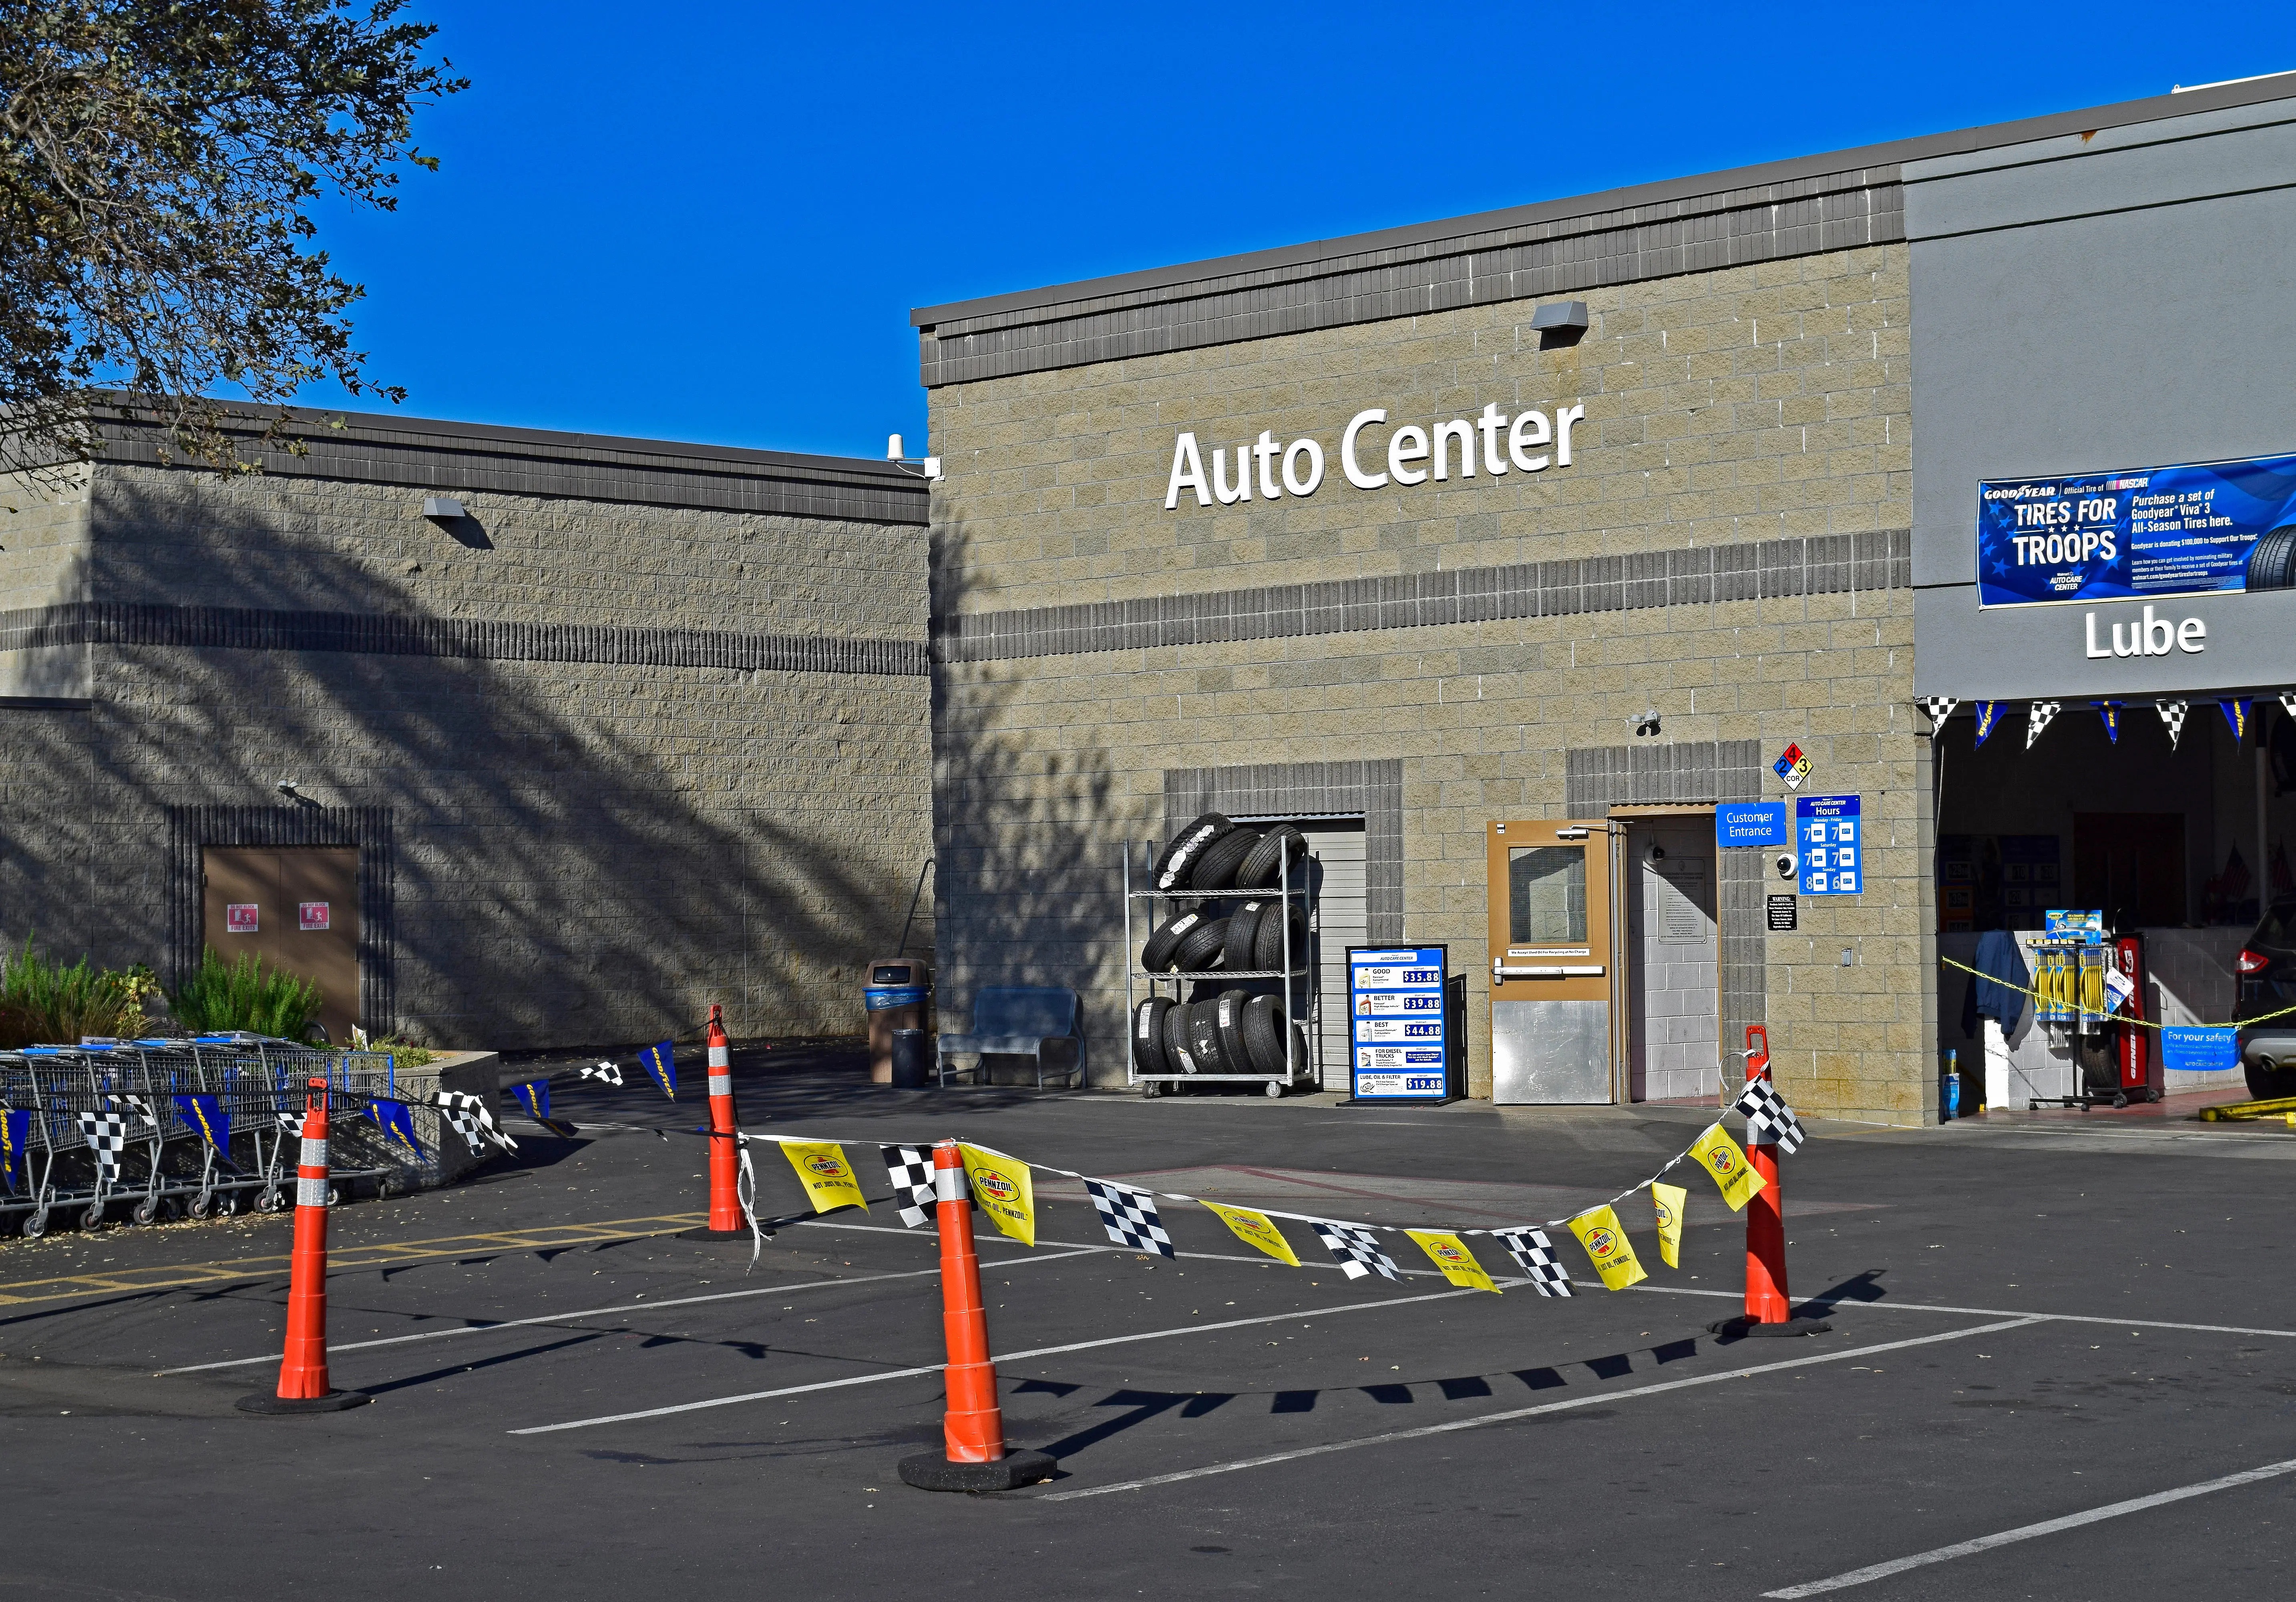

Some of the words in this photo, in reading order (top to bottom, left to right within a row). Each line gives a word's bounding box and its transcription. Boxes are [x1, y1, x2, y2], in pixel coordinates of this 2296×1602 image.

[1164, 429, 1325, 511] Auto
[1341, 402, 1585, 490] Center
[1984, 485, 2055, 500] GOODYEAR
[2064, 485, 2084, 494] Official
[2120, 478, 2148, 489] NASCAR
[2132, 495, 2175, 507] Purchase
[2178, 494, 2184, 503] a
[2187, 491, 2202, 502] set
[2205, 489, 2215, 500] of
[2014, 501, 2071, 526] TIRES
[2078, 498, 2117, 522] FOR
[2204, 502, 2210, 513] 3
[2132, 521, 2181, 533] All-Season
[2184, 518, 2207, 529] Tires
[2210, 515, 2233, 527] here.
[2181, 537, 2203, 546] $100,000
[2210, 536, 2229, 544] Support
[2013, 530, 2117, 566] TROOPS
[2086, 606, 2206, 659] Lube
[1788, 747, 1796, 760] 4
[1778, 759, 1787, 773] 2
[1799, 759, 1807, 773] 3
[1816, 807, 1840, 815] Hours
[1727, 813, 1773, 823] Customer
[1729, 827, 1772, 837] Entrance
[1804, 828, 1810, 841] 7
[1832, 827, 1839, 839] 7
[1805, 853, 1811, 865] 7
[1832, 852, 1839, 865] 7
[1806, 876, 1813, 890] 8
[1833, 876, 1840, 889] 6
[1404, 971, 1439, 982] $35.88
[1405, 998, 1440, 1008] $39.88
[1406, 1024, 1440, 1035] $44.88
[2168, 1032, 2182, 1040] For
[2183, 1034, 2204, 1042] your
[2206, 1033, 2231, 1043] safety
[1407, 1079, 1442, 1089] $19.88
[811, 1161, 841, 1171] PENNZOIL
[1715, 1151, 1728, 1170] PENNZOIL
[979, 1176, 1013, 1192] PENNZOIL
[993, 1203, 1001, 1214] OIL,
[1589, 1233, 1611, 1253] PENNZOIL
